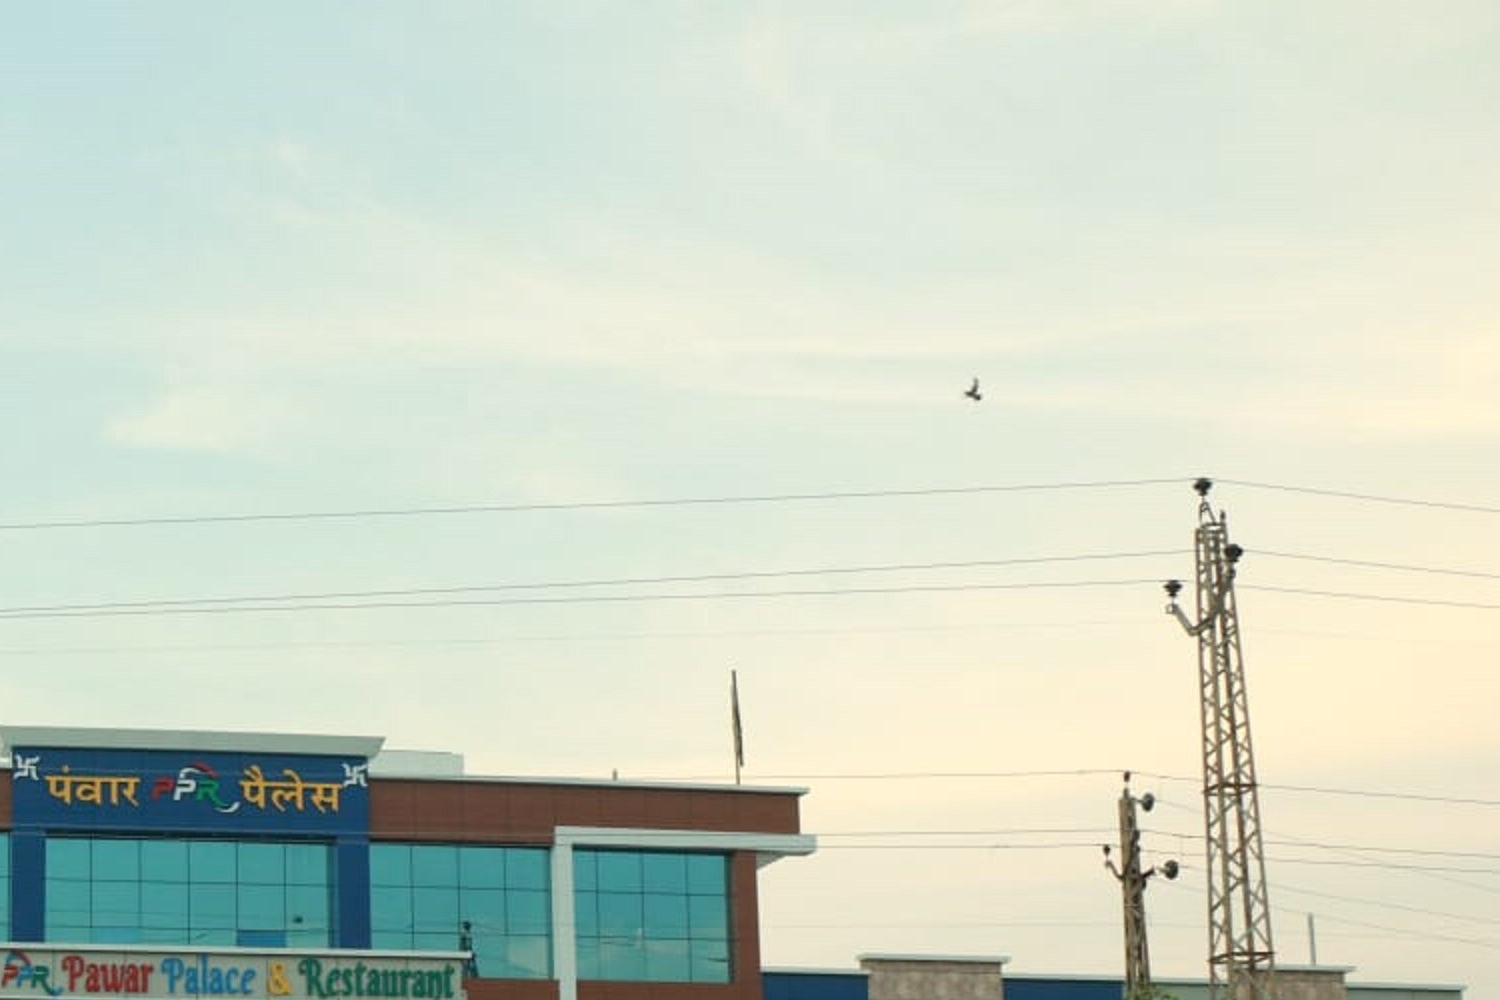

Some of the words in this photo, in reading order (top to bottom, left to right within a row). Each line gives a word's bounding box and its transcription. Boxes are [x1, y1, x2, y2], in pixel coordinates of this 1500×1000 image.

[45, 765, 141, 807] पंवार
[240, 765, 343, 814] पैलेस
[61, 954, 154, 993] Pawar
[161, 953, 257, 995] Palace
[268, 959, 292, 996] &
